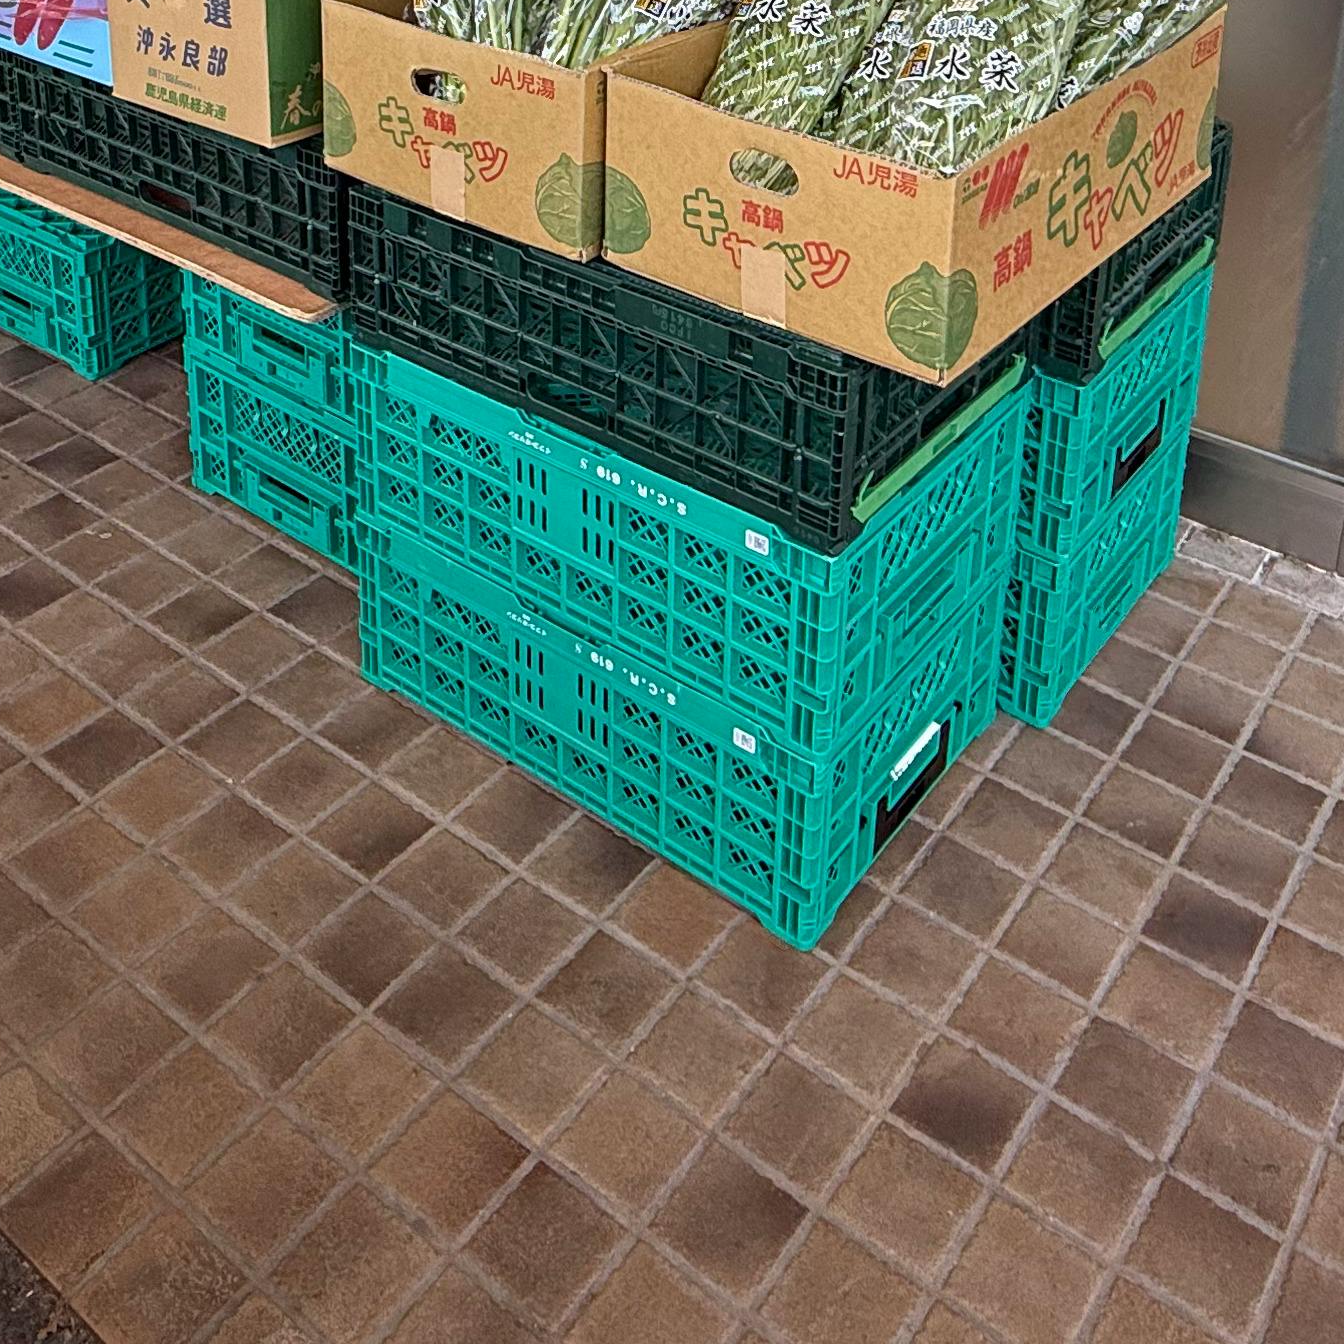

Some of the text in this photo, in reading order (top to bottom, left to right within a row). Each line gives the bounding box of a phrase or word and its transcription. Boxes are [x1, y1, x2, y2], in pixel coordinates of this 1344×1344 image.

[928, 15, 998, 41] 福岡県産
[136, 24, 229, 77] 沖永良部
[858, 47, 892, 82] 水
[935, 44, 1020, 93] 水菜
[491, 64, 556, 100] JA児湯
[422, 106, 456, 136] 高鍋
[833, 154, 919, 199] JA児湯
[1047, 107, 1184, 251] キャベツ
[741, 199, 785, 234] 高鍋
[992, 229, 1033, 293] 高鍋
